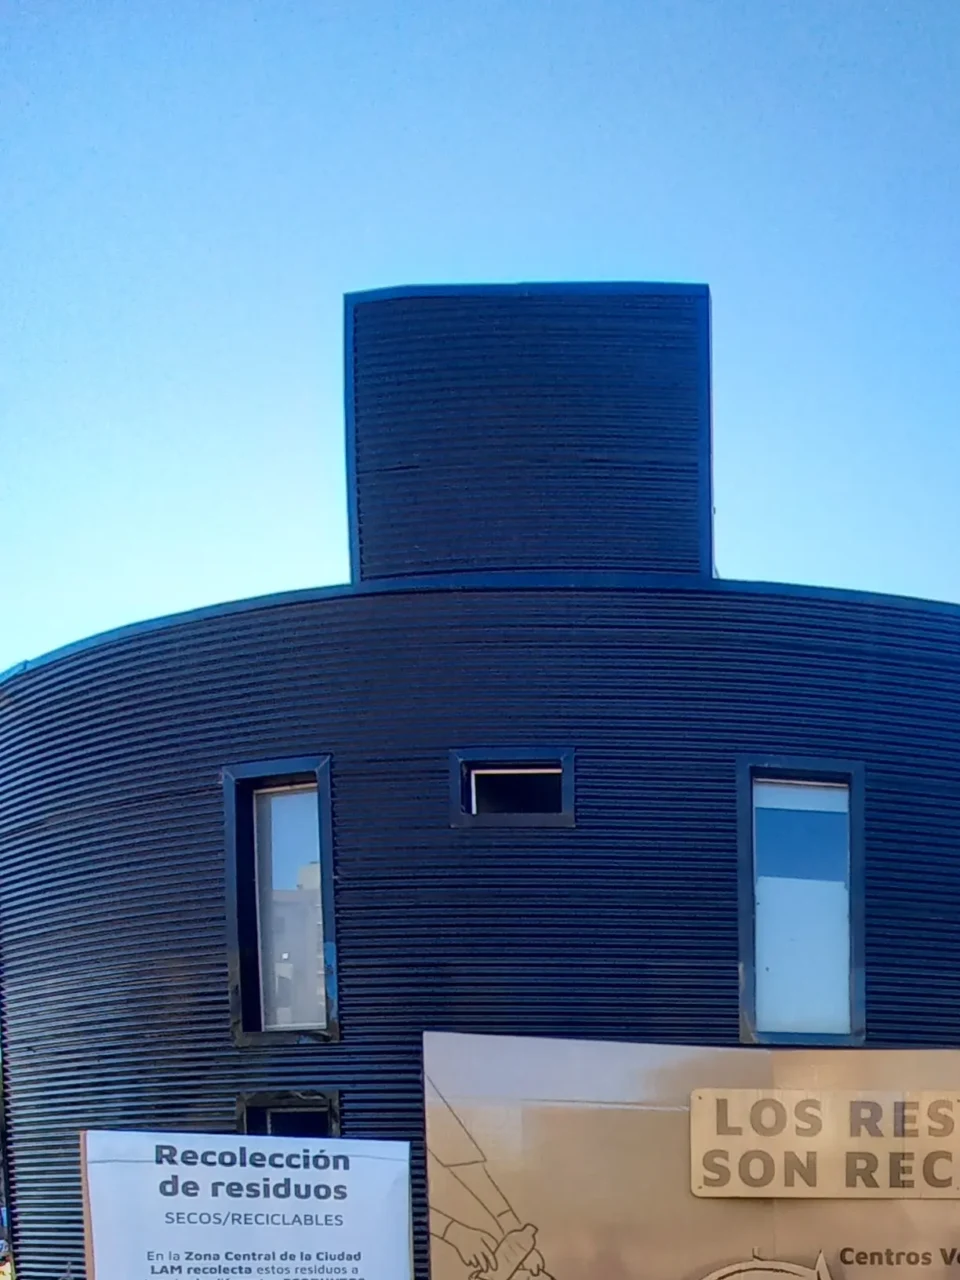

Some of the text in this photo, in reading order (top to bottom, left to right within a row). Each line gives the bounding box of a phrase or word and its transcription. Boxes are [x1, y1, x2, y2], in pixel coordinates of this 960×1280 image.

[715, 1098, 824, 1138] LOS
[154, 1144, 350, 1171] Recolección
[702, 1149, 818, 1189] SON
[159, 1175, 348, 1200] de residuos
[164, 1211, 344, 1226] SECOS/RECICLABLES
[146, 1251, 362, 1262] En la Zona Central de la Ciudad
[839, 1247, 933, 1266] Centros
[150, 1264, 359, 1275] LAM recolecta estos residuos a
